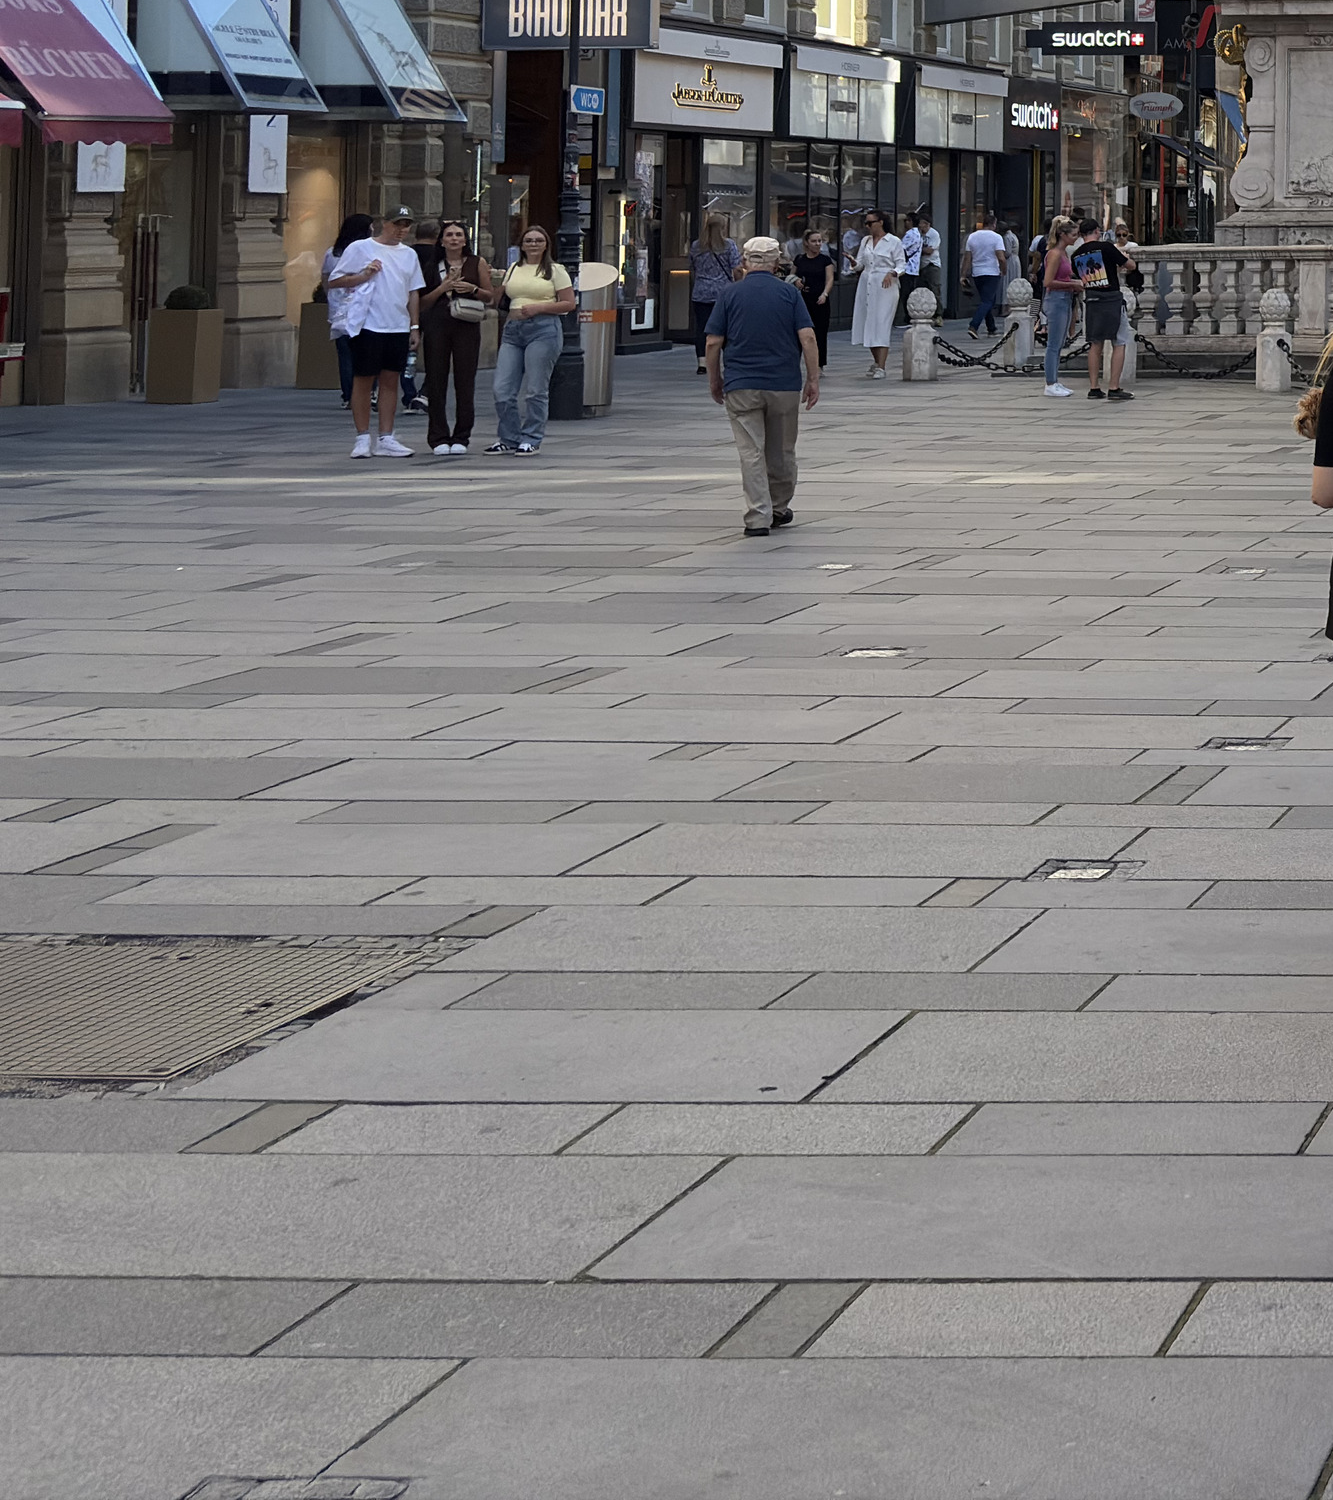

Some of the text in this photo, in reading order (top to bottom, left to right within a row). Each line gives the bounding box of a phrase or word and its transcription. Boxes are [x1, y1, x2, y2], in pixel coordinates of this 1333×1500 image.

[1052, 30, 1131, 47] swatch
[1, 40, 131, 80] BÜCHER
[580, 92, 593, 108] WC
[1135, 99, 1175, 114] Triumph
[1011, 100, 1053, 131] swatch
